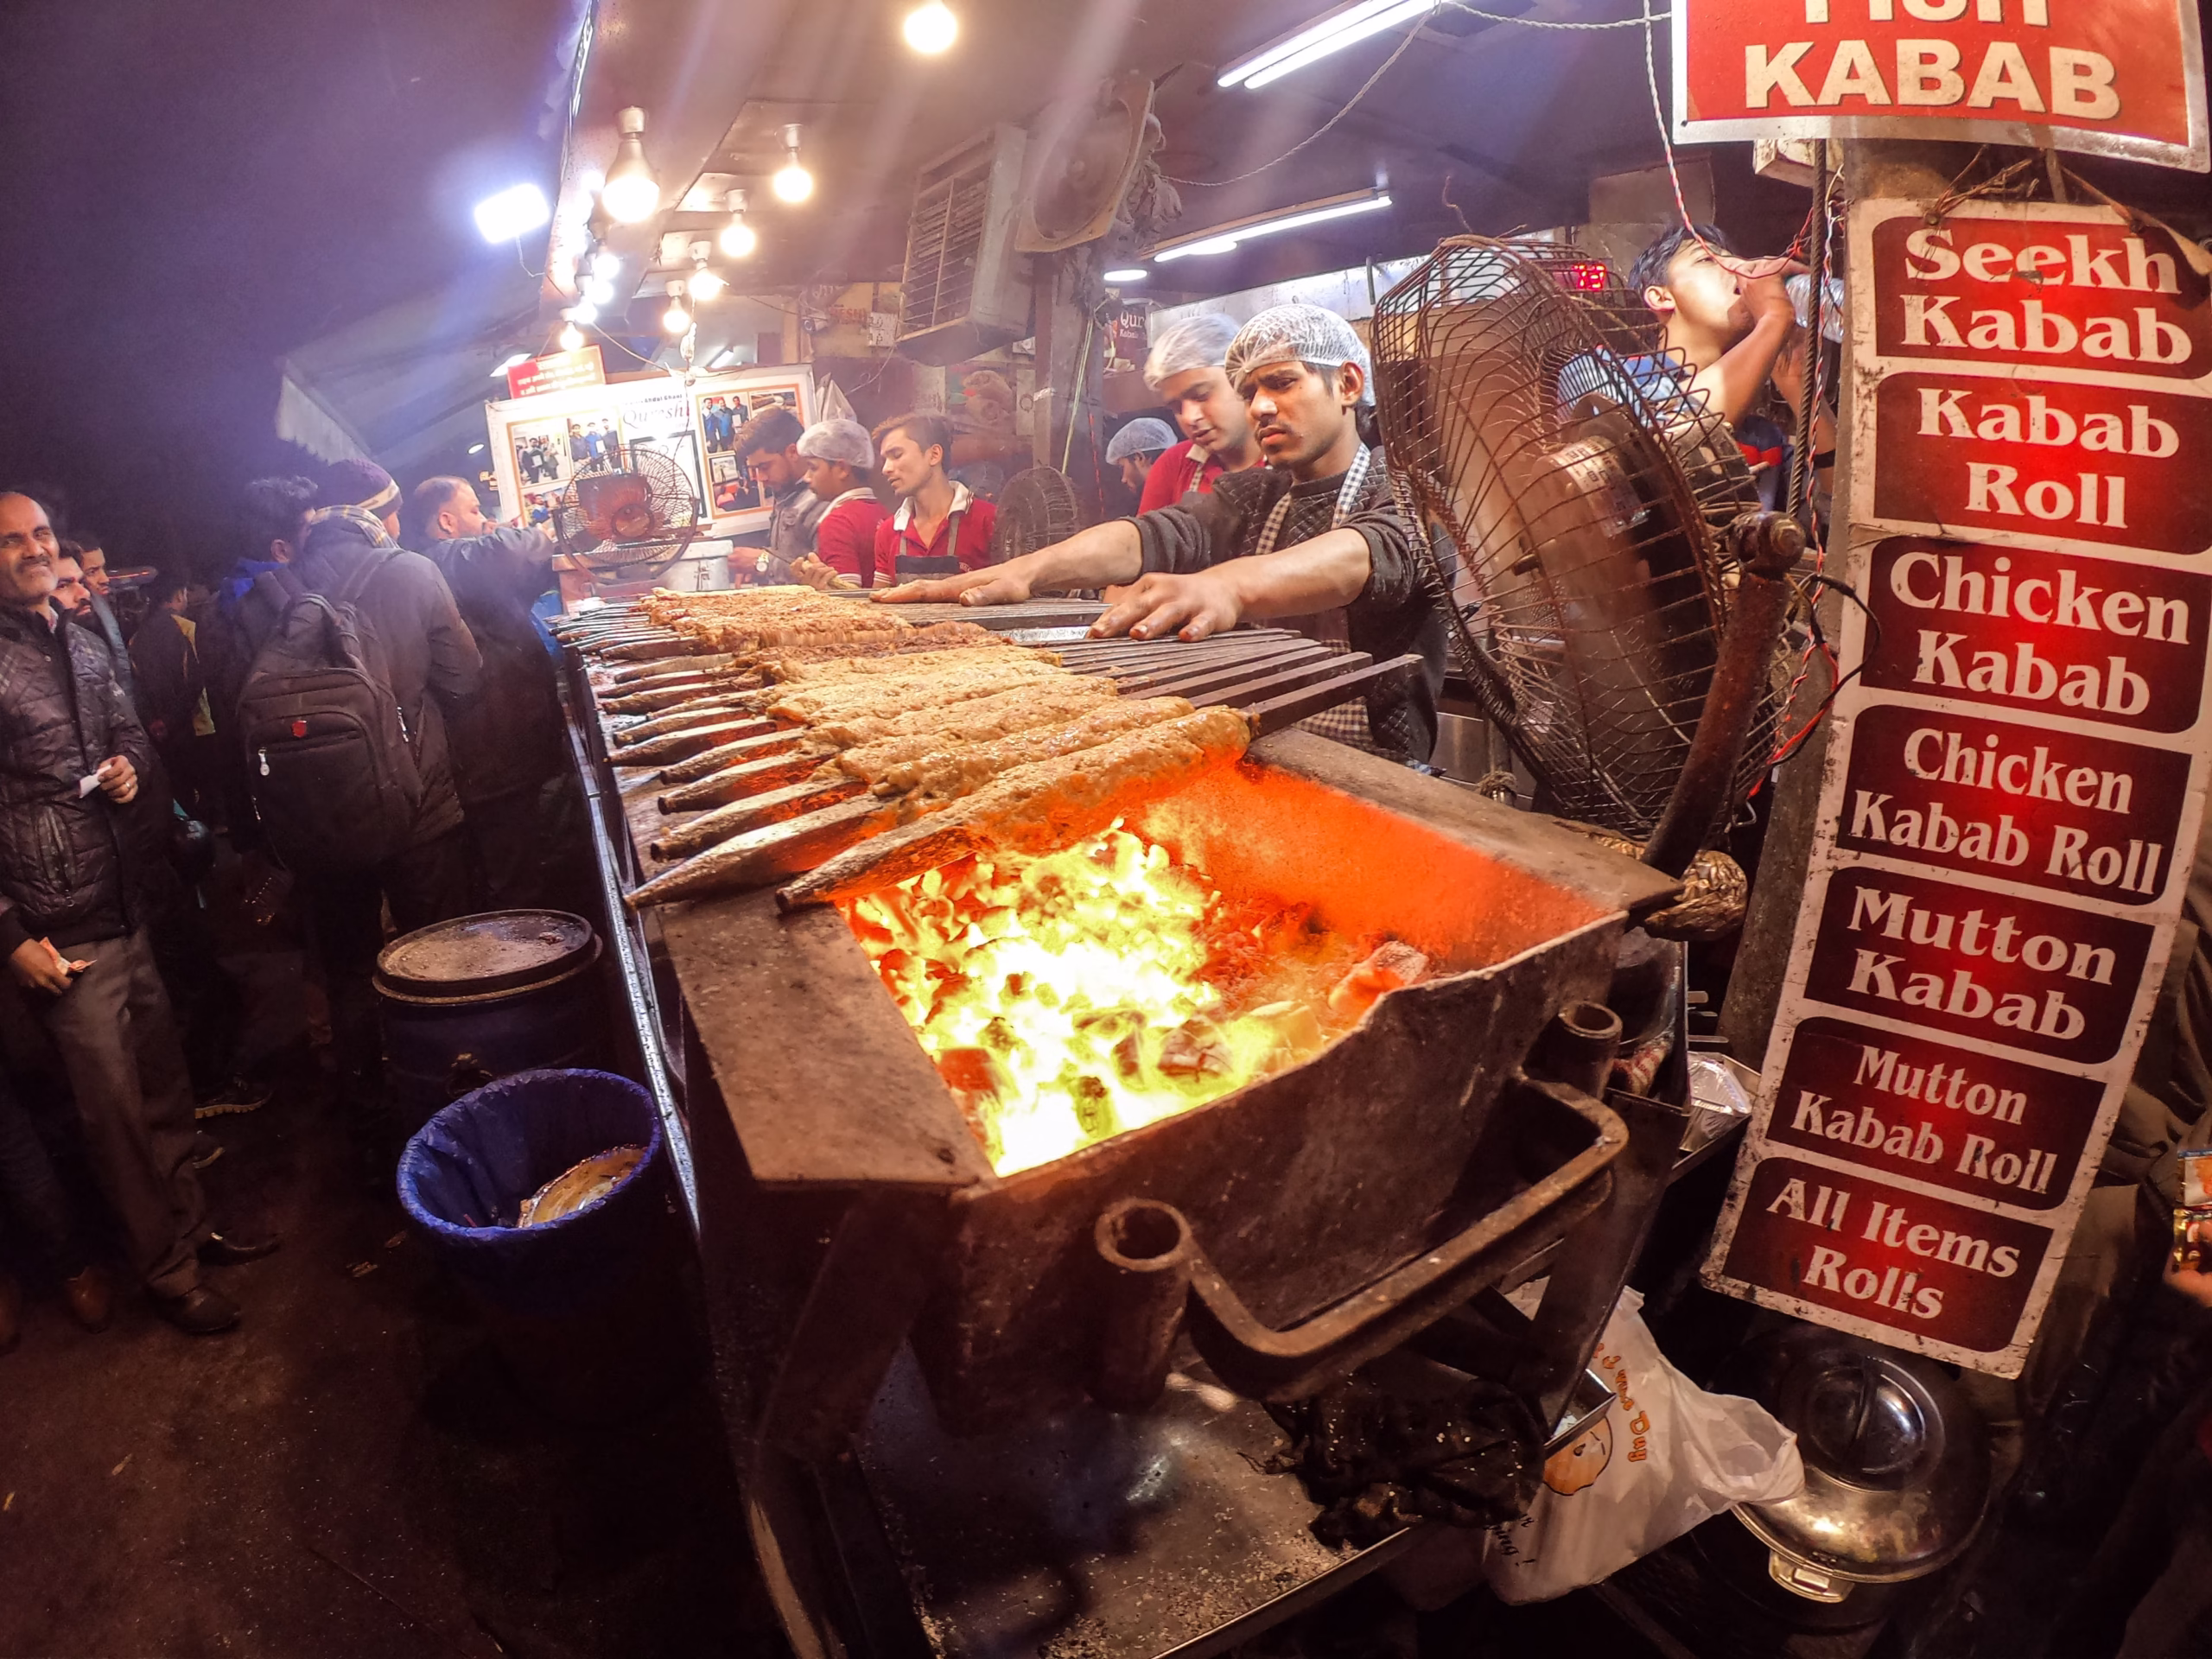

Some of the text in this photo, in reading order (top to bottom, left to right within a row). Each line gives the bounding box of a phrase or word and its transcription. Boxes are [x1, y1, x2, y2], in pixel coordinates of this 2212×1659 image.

[1745, 39, 2120, 119] KABAB
[1904, 229, 2183, 295] Seekh
[1900, 294, 2193, 366] Kabab
[1916, 387, 2181, 459] Kabab
[1964, 461, 2128, 530] Roll
[1890, 551, 2190, 645] Chicken
[1912, 629, 2151, 715] Kabab
[1904, 728, 2134, 815] Chicken
[1850, 790, 2163, 895] Kabab Roll
[1847, 886, 2120, 986] Mutton
[1846, 949, 2086, 1040] Kabab
[1853, 1045, 2029, 1126] Mutton
[1789, 1090, 2058, 1195] Kabab Roll
[1766, 1177, 2022, 1278] All Items
[1802, 1245, 1945, 1320] Rolls
